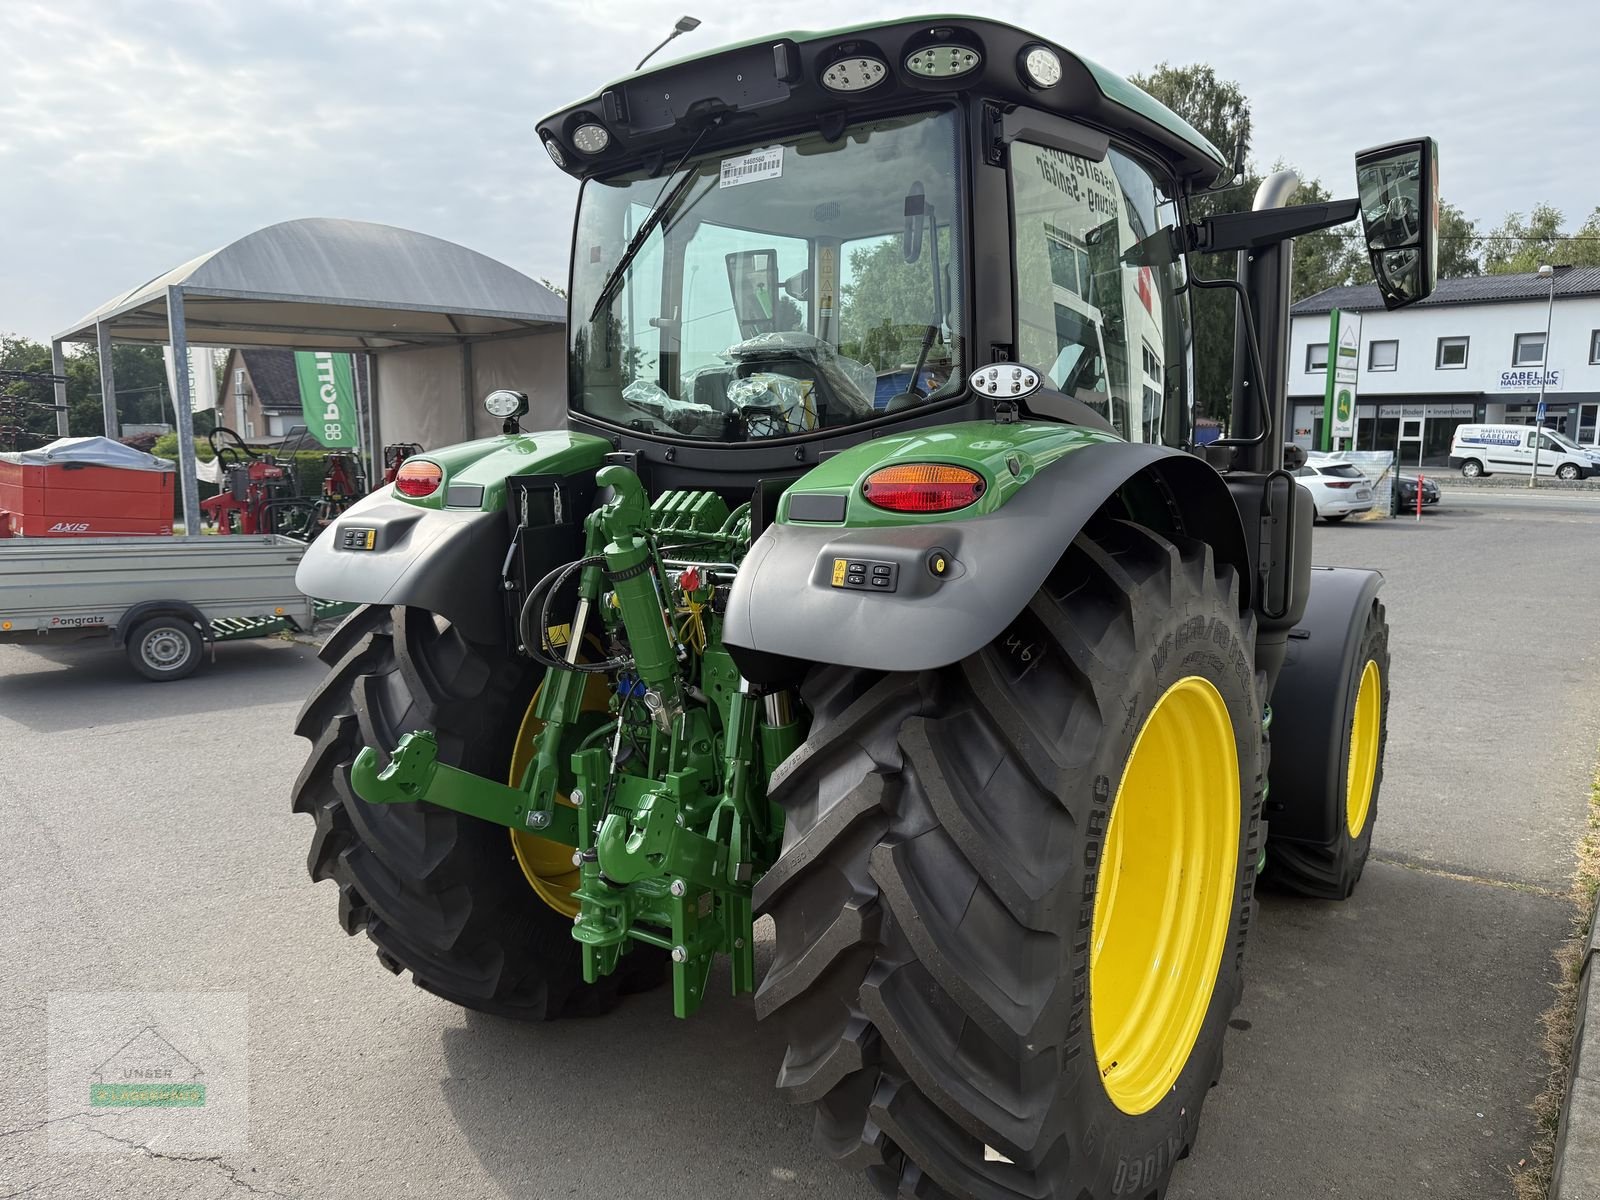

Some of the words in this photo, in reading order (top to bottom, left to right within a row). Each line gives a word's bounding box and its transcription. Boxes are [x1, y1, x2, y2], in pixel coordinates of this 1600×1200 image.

[1501, 371, 1559, 380] GABELIC
[50, 522, 90, 532] AXIS
[52, 615, 105, 627] Pongratz
[1062, 773, 1111, 1074] TRELLEBORG
